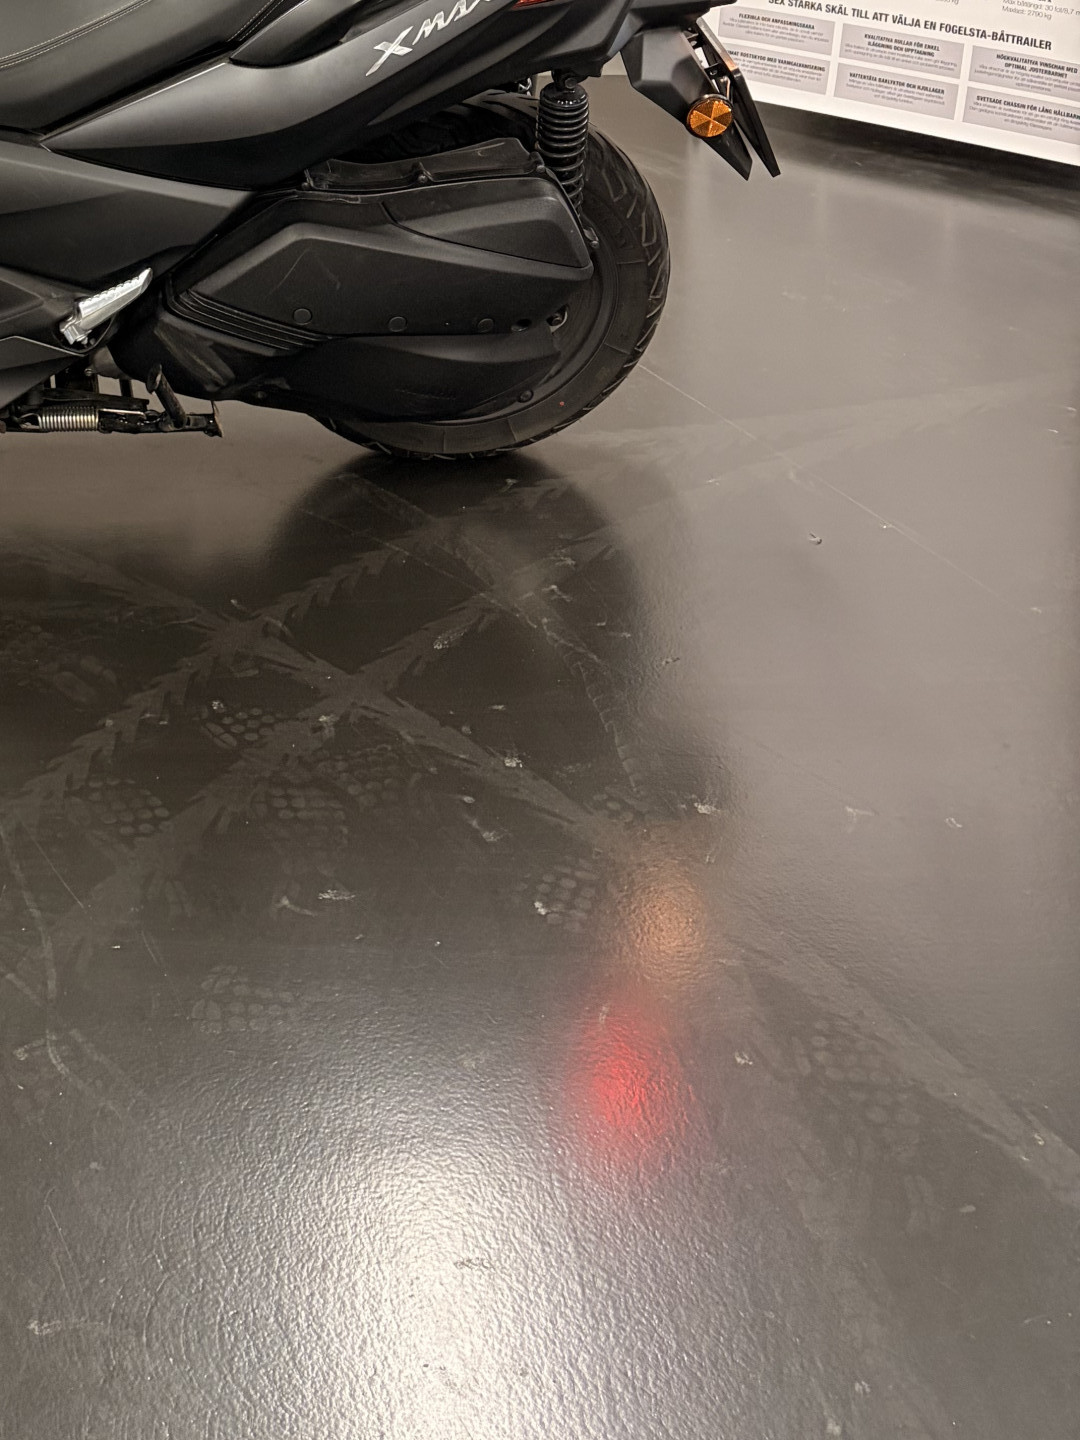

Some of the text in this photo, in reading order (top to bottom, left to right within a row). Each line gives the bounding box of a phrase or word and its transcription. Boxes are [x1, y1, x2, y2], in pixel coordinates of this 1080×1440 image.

[825, 4, 848, 16] SKÄL
[851, 8, 870, 20] TILL
[872, 12, 889, 22] ATT
[892, 14, 920, 28] VÄLJA
[924, 20, 936, 30] EN
[940, 23, 1052, 50] FOGELSTA-BÅTTRAILER
